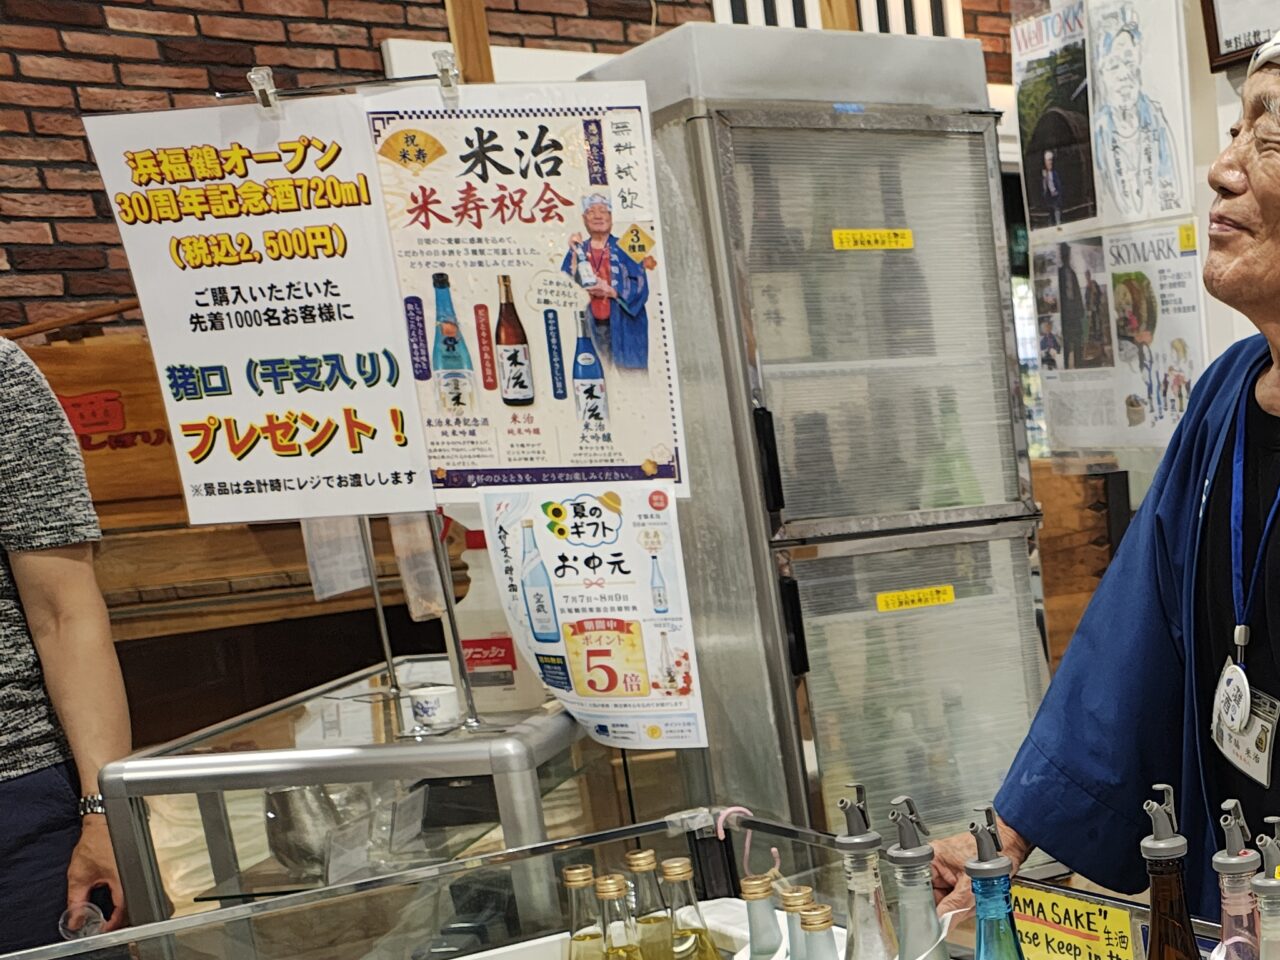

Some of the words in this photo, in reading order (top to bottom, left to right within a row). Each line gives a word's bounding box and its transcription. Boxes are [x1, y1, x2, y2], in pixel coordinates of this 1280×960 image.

[405, 133, 418, 147] 祝
[124, 137, 342, 185] 浜福鶴オープン
[400, 148, 427, 165] 米寿
[456, 124, 564, 183] 米治
[115, 174, 372, 225] 30周年記念酒720ml
[402, 182, 575, 230] 米寿祝会
[631, 229, 640, 244] 3
[193, 279, 341, 308] ご購入いただいた
[188, 303, 354, 333] 先着1000名お客様に
[509, 413, 534, 424] 米治
[582, 422, 605, 433] 米治
[579, 432, 613, 444] 大吟醸
[571, 501, 603, 520] 夏の
[570, 520, 614, 539] ギフト
[554, 552, 632, 579] お中元
[582, 635, 624, 646] ポイント
[586, 649, 618, 693] 5
[623, 673, 641, 693] 倍
